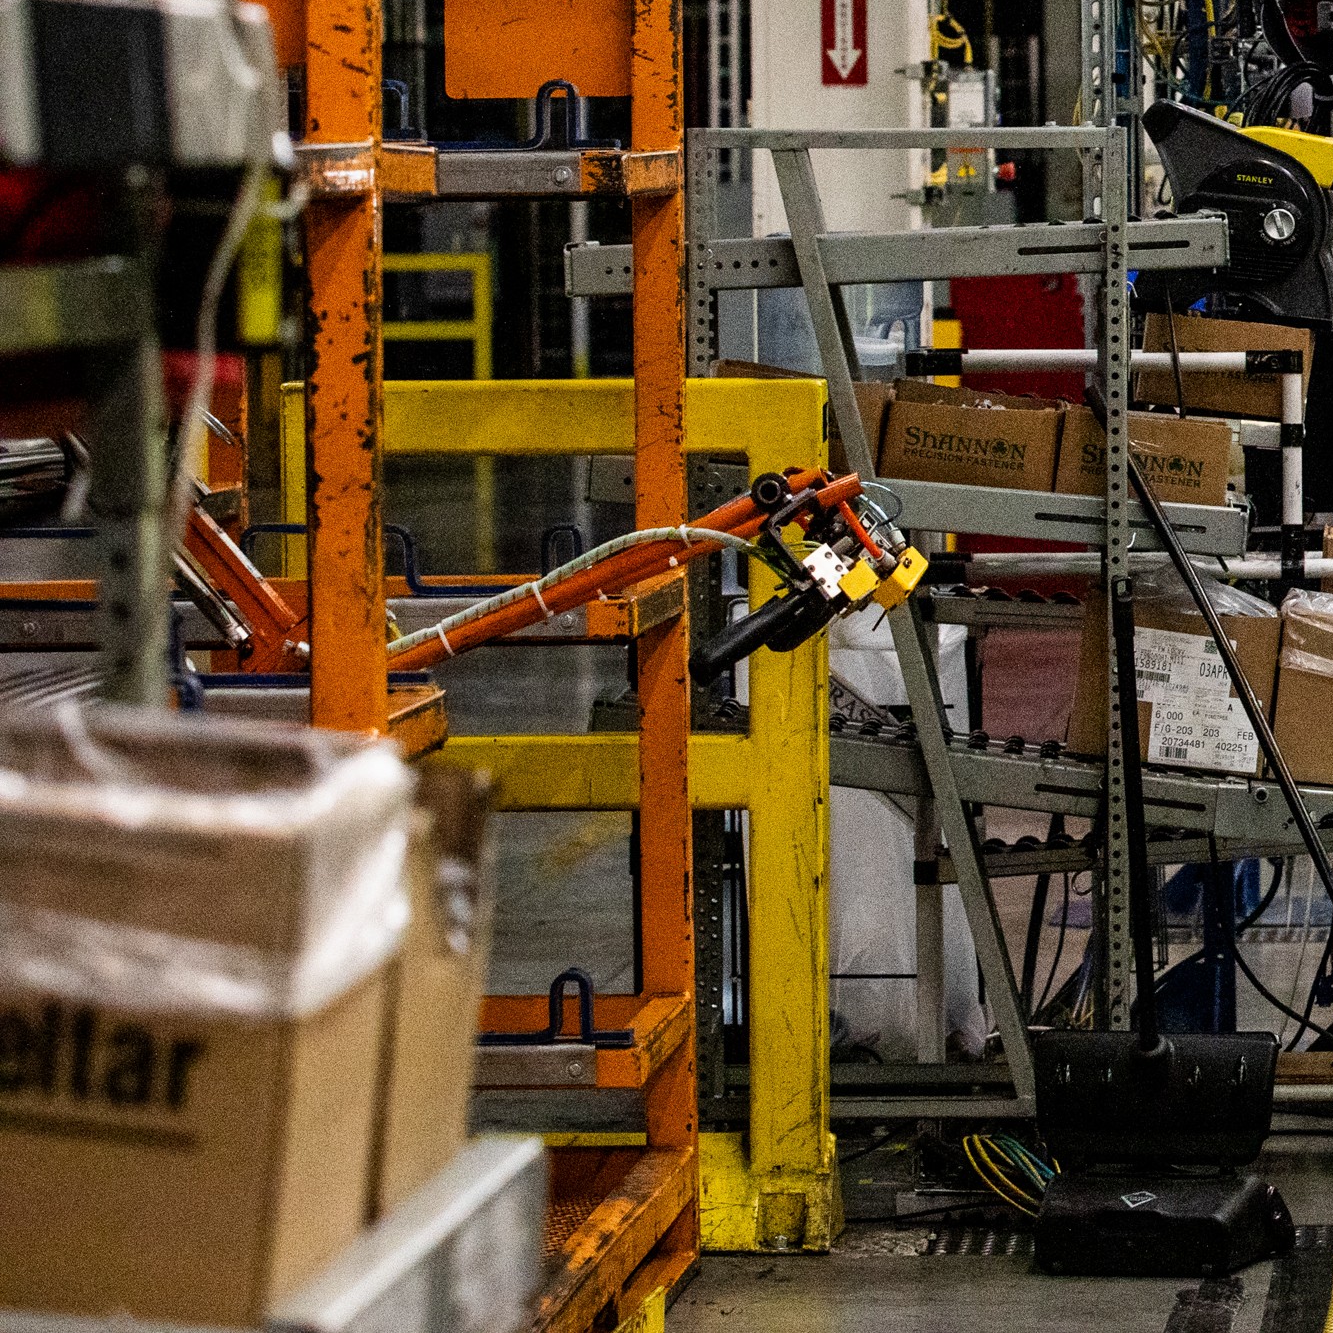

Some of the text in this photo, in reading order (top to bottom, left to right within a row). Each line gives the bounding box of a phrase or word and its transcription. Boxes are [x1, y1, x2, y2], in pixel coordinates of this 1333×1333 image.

[1236, 174, 1274, 185] STANLEY
[1155, 710, 1183, 720] 6,000
[1154, 724, 1254, 740] F/G-203 203 FEB
[1162, 737, 1247, 752] 20734481 402251
